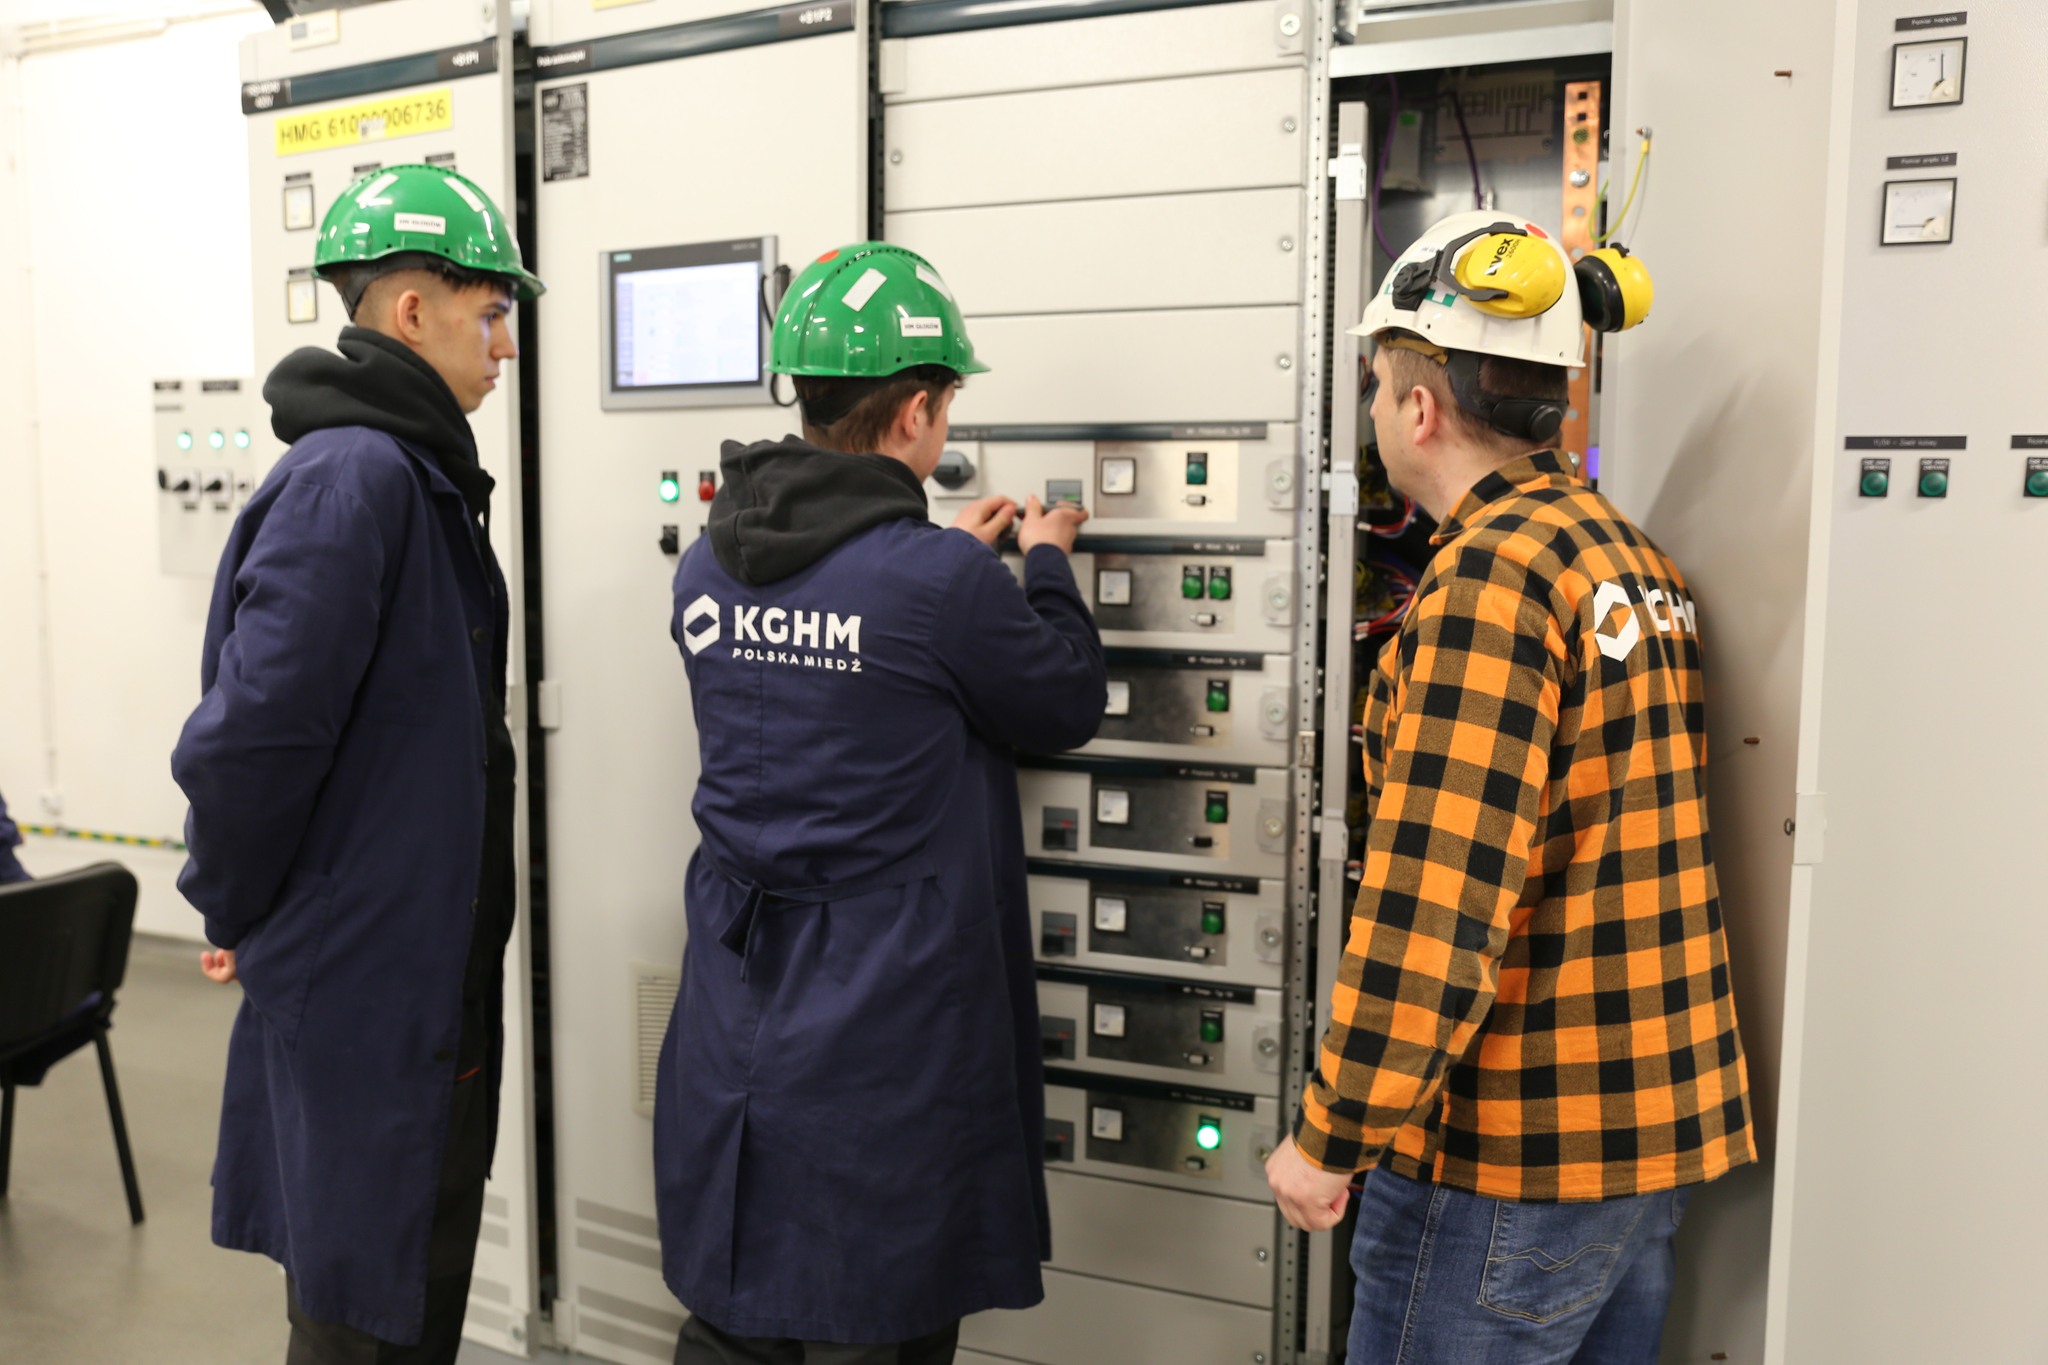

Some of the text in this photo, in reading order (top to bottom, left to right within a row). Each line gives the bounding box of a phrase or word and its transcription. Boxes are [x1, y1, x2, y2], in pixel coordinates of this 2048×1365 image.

[281, 121, 322, 145] HMG
[1485, 238, 1514, 276] uvex
[734, 604, 862, 654] KGHM
[732, 647, 800, 666] POLSKA
